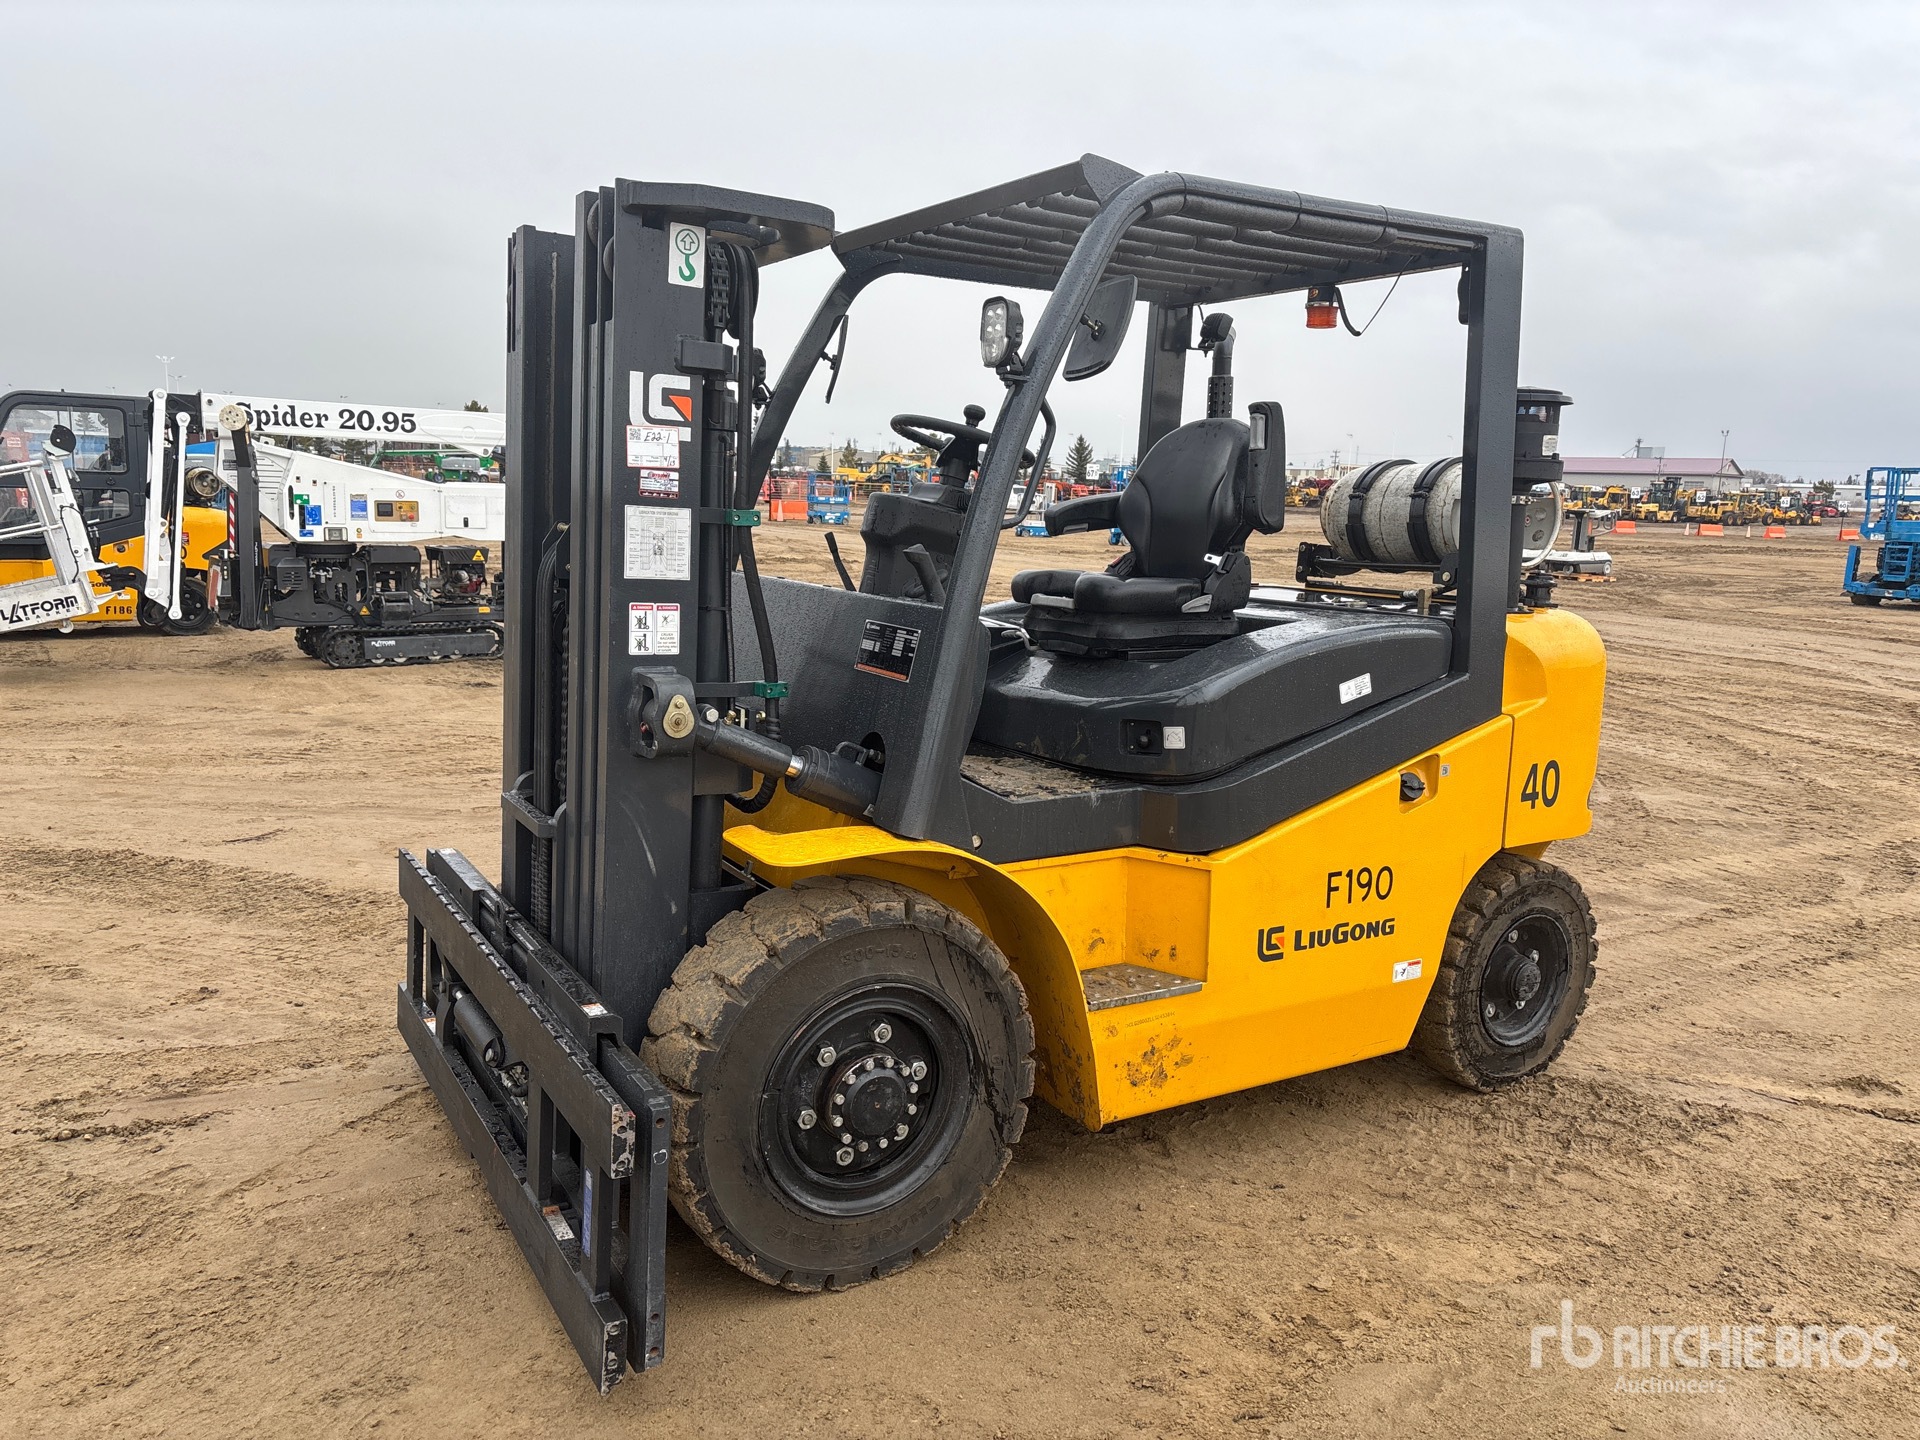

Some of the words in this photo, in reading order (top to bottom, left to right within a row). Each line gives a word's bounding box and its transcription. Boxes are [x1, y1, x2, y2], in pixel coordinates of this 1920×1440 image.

[235, 402, 329, 431] Spider
[339, 409, 417, 433] 20.95
[643, 431, 671, 443] E22-1
[0, 595, 79, 625] LATFORM
[105, 606, 133, 615] F186
[1521, 759, 1561, 810] 40
[1326, 865, 1394, 909] F190
[1293, 917, 1396, 952] LIUGONG
